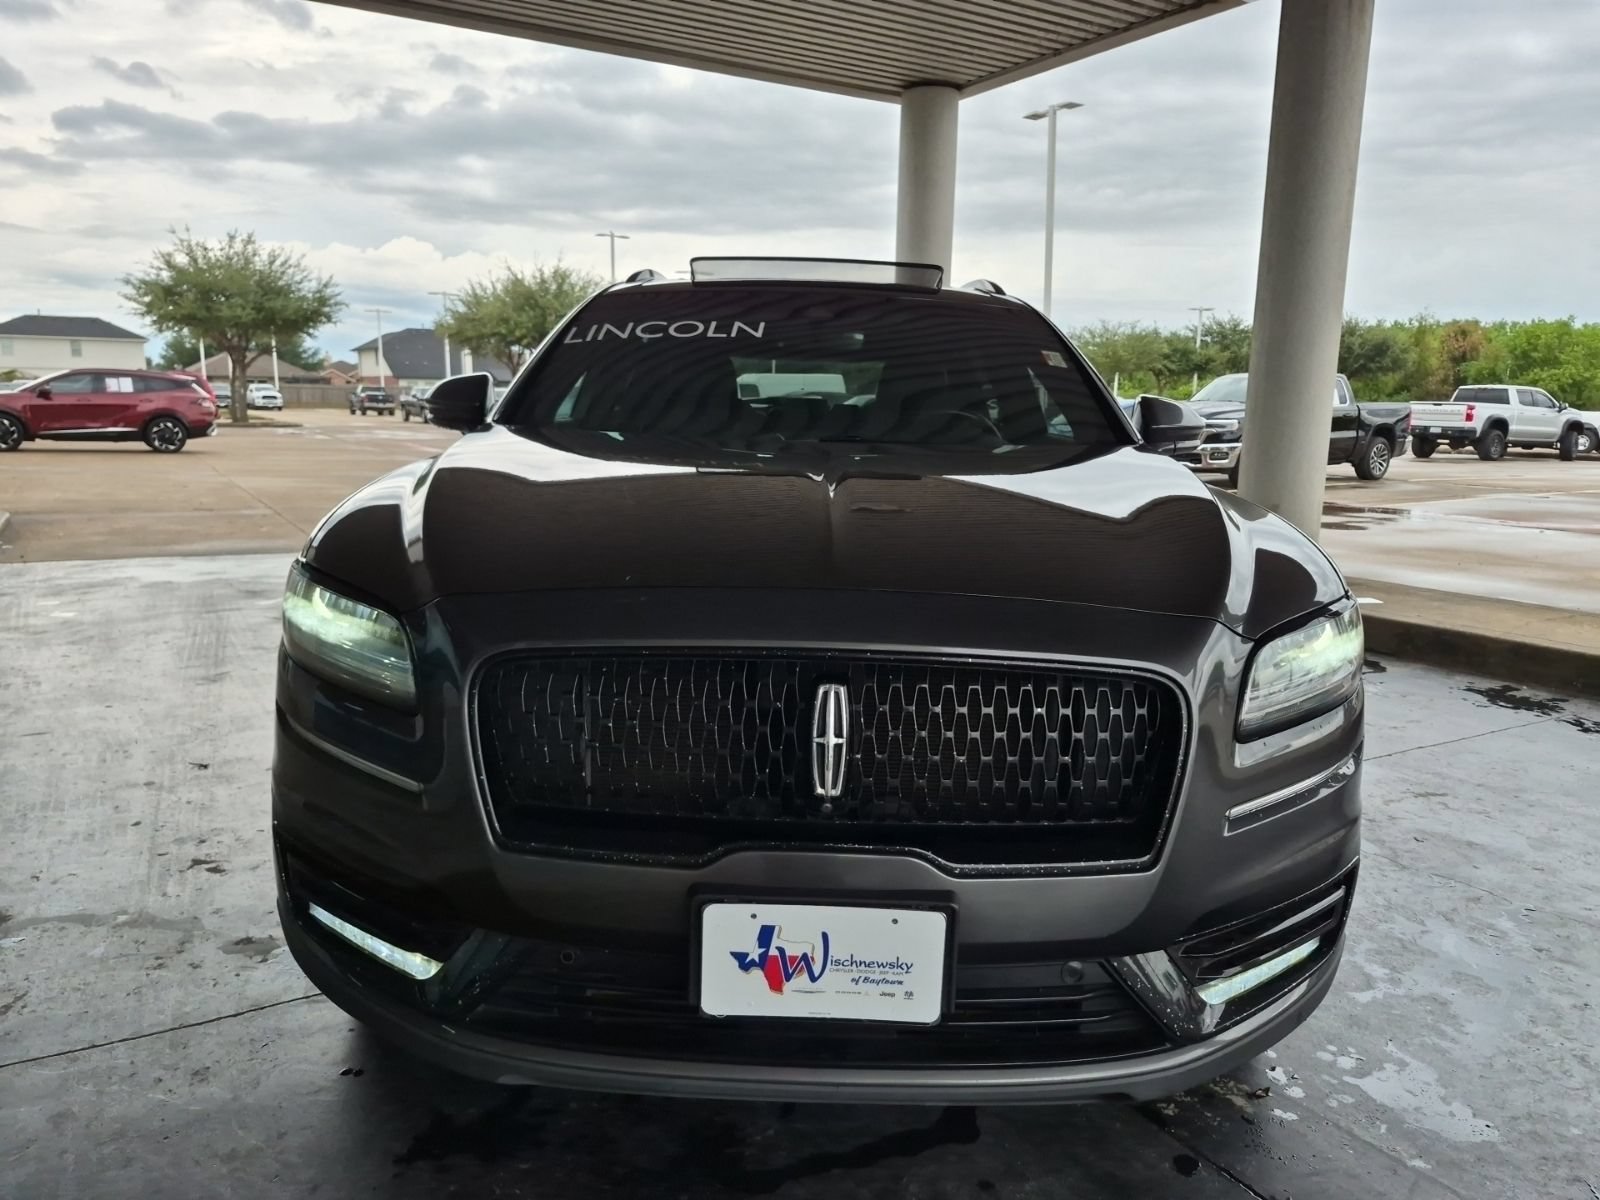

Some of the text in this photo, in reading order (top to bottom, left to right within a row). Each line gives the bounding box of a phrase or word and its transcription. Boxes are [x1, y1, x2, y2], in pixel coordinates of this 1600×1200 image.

[563, 320, 766, 344] LINCOLN
[774, 931, 913, 983] Wischnewsky
[850, 976, 904, 986] of Baytown
